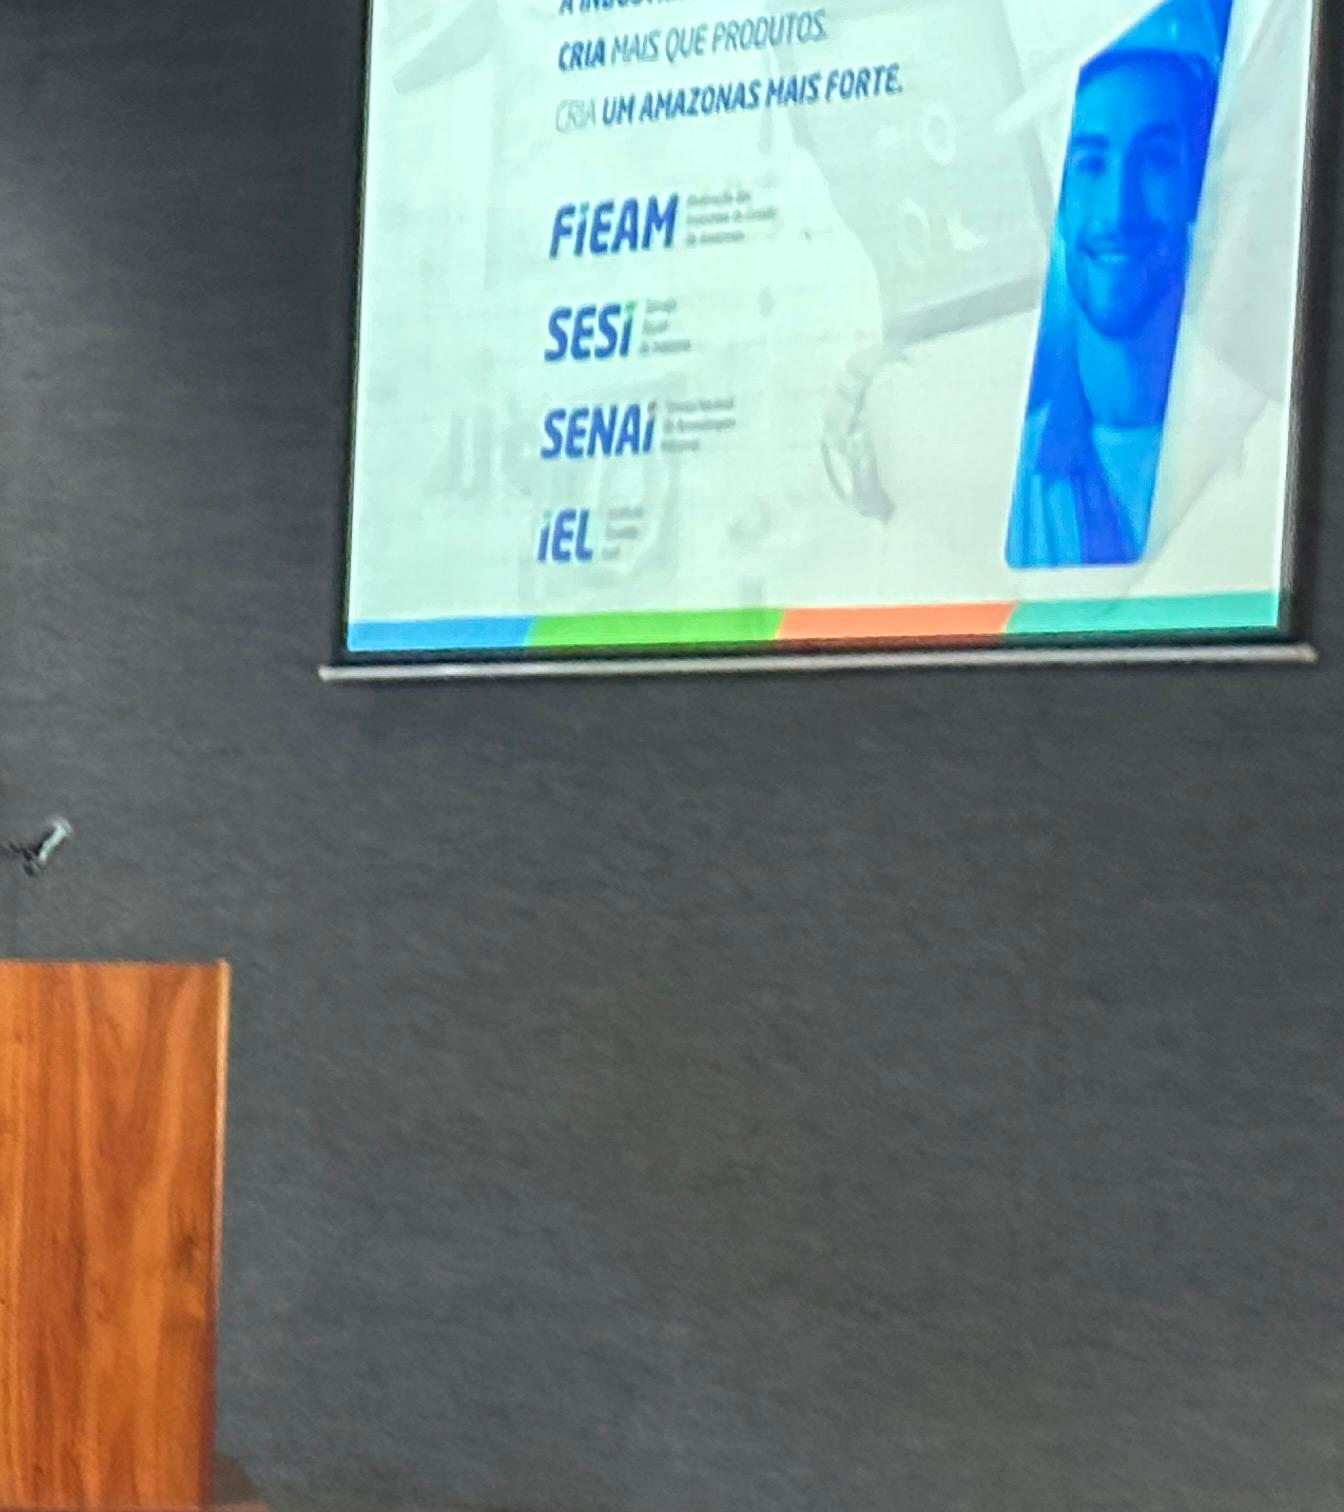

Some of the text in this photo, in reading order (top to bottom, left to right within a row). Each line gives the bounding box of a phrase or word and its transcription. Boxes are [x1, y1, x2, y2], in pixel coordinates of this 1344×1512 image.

[558, 36, 606, 72] CRIA
[610, 30, 661, 63] MAIS
[665, 23, 708, 63] QUE
[555, 62, 904, 132] CRIA UM AMAZONAS MAIS FORTE.
